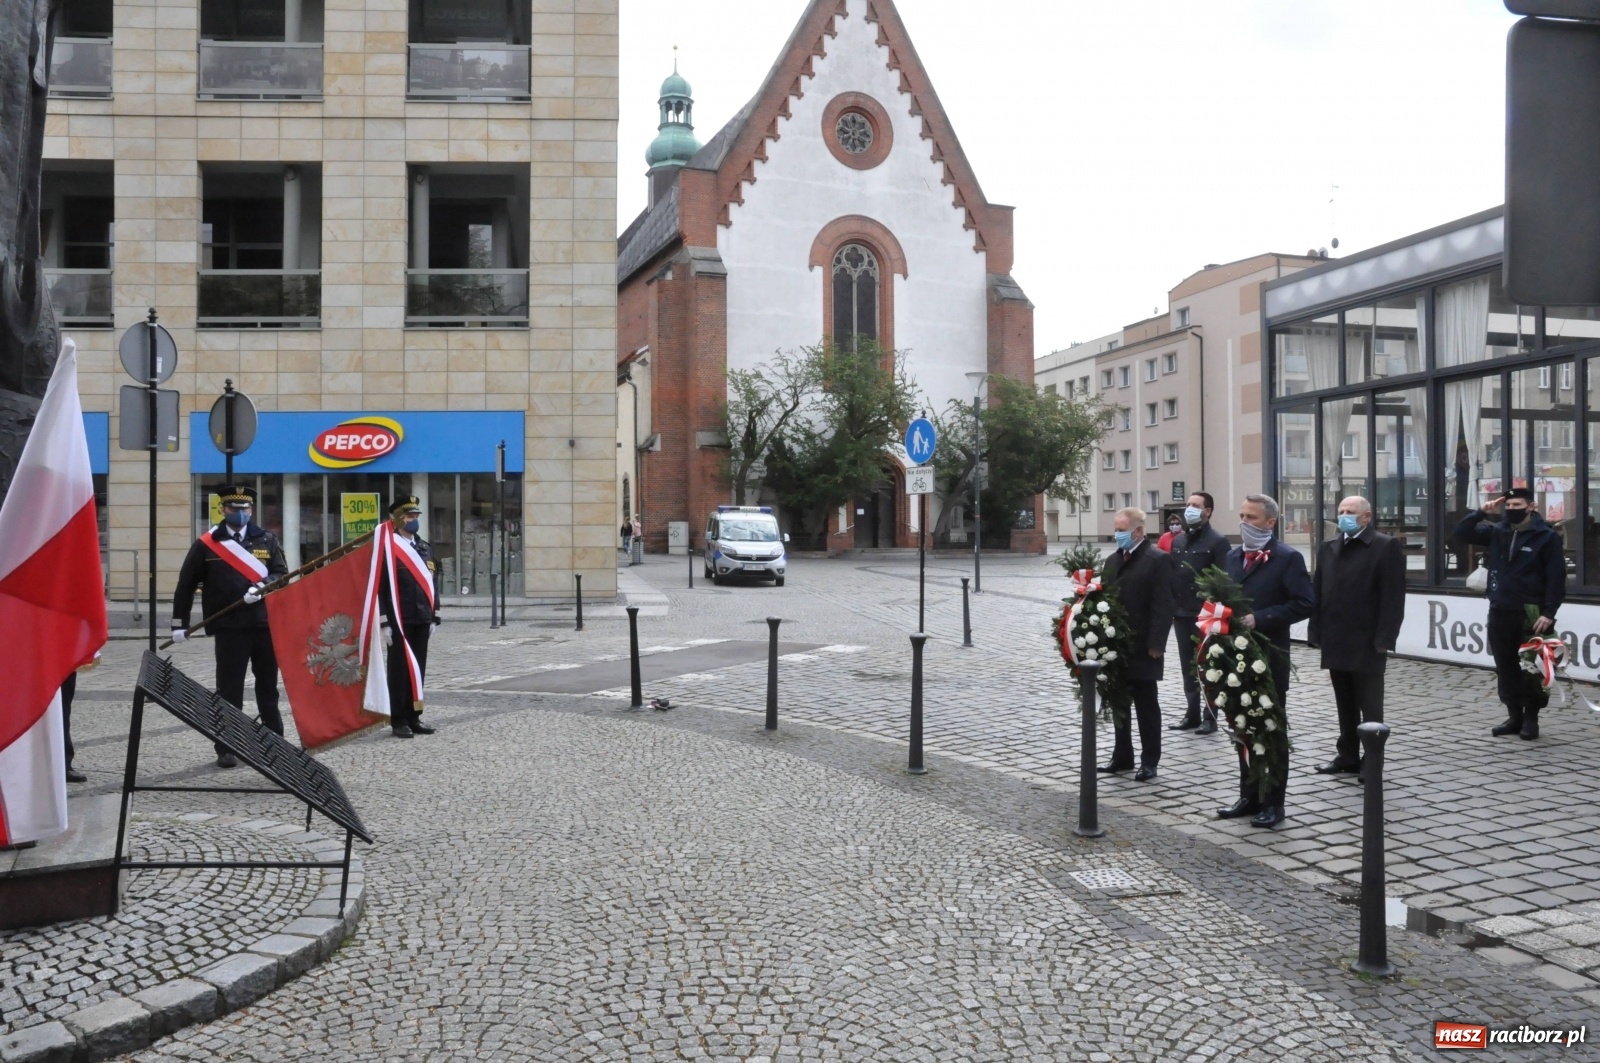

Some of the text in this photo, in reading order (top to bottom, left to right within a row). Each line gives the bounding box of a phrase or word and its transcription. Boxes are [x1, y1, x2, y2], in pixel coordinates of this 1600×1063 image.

[323, 434, 389, 450] PEPCO
[344, 500, 375, 514] -30%
[346, 523, 357, 532] NA
